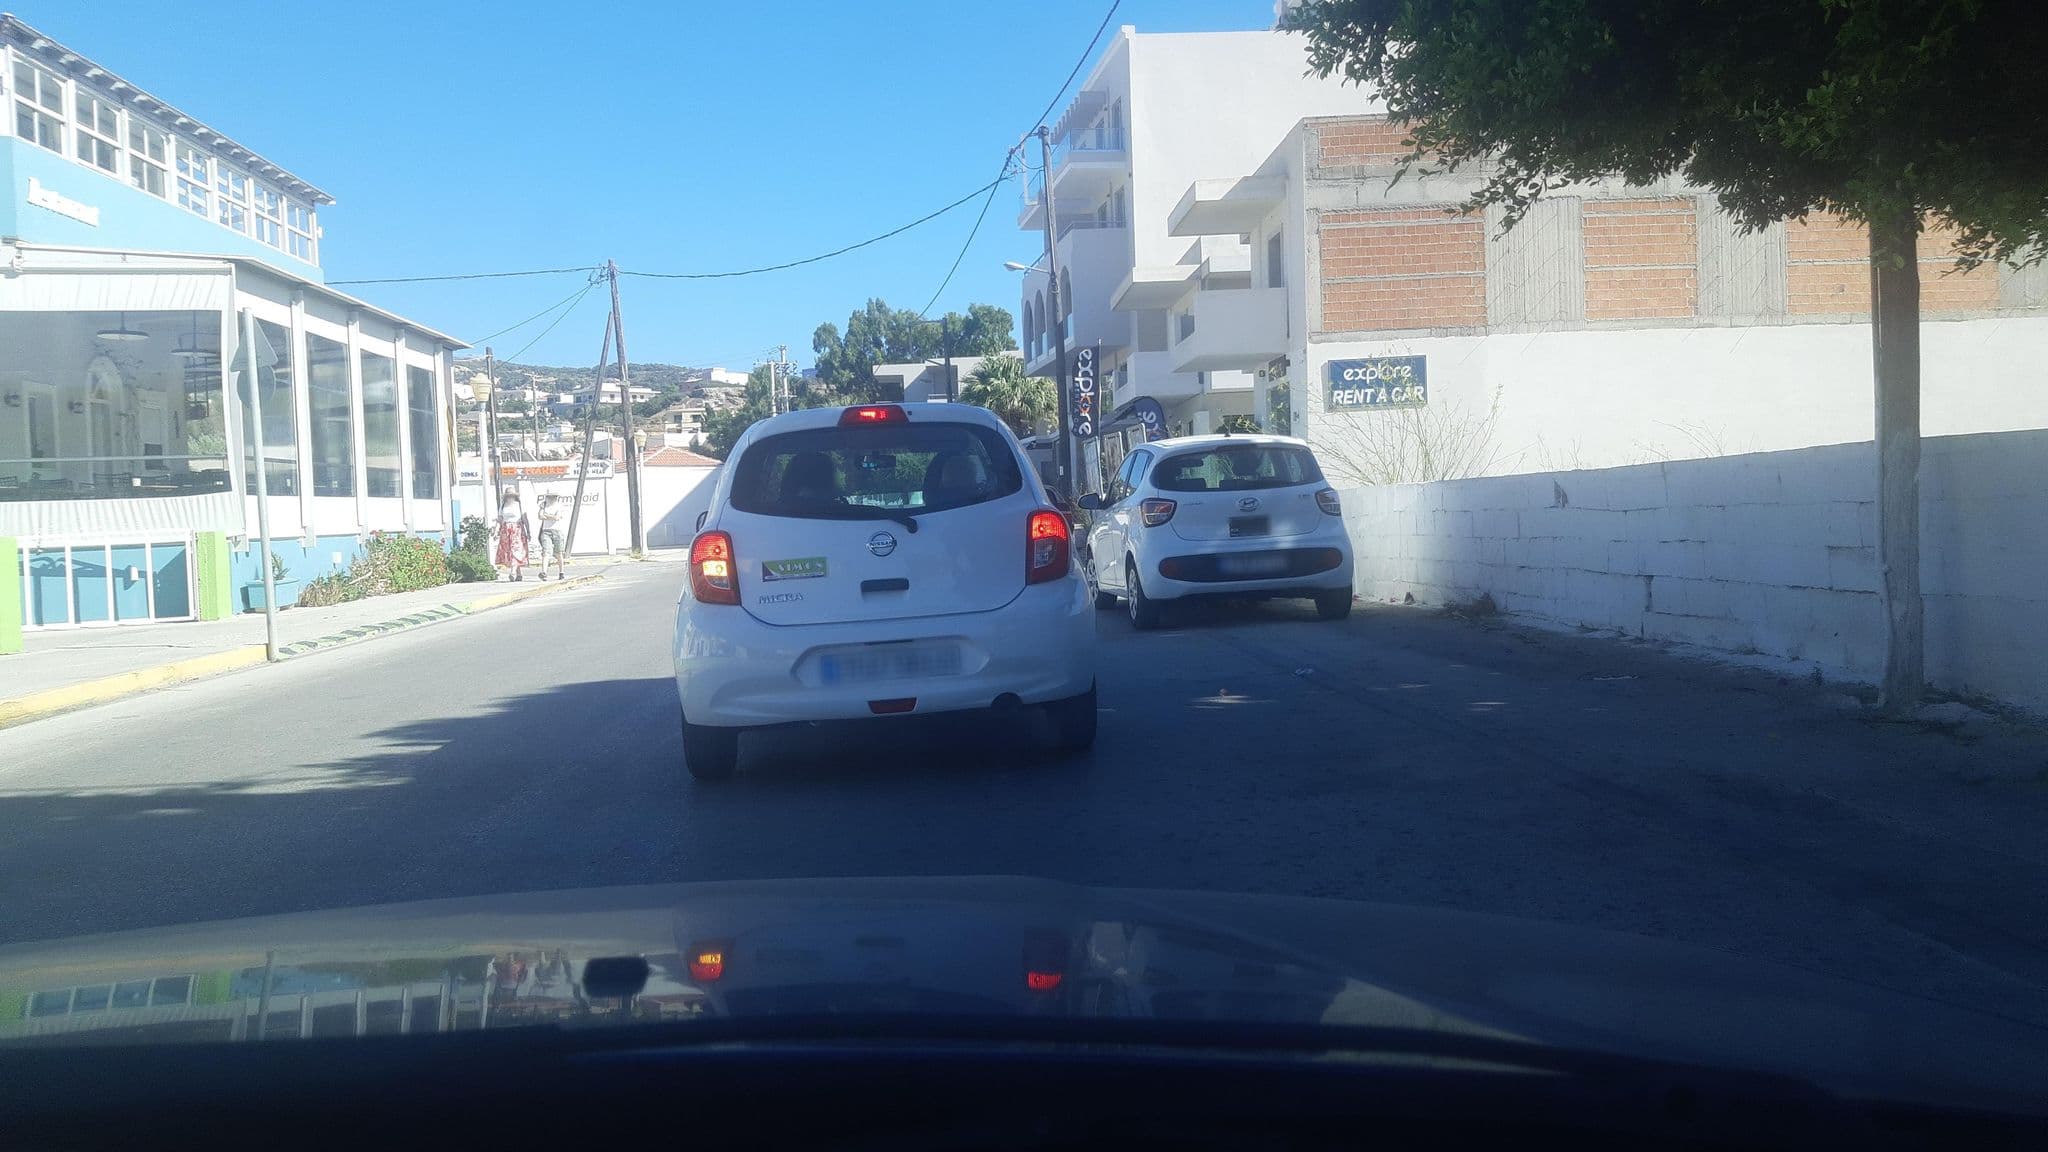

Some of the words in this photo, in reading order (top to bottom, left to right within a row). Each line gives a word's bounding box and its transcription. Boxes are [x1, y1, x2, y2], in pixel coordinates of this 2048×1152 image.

[1343, 362, 1413, 385] explore
[1074, 348, 1095, 436] explore
[1333, 388, 1375, 405] RENT
[1376, 388, 1387, 403] A
[1391, 385, 1425, 403] CAR
